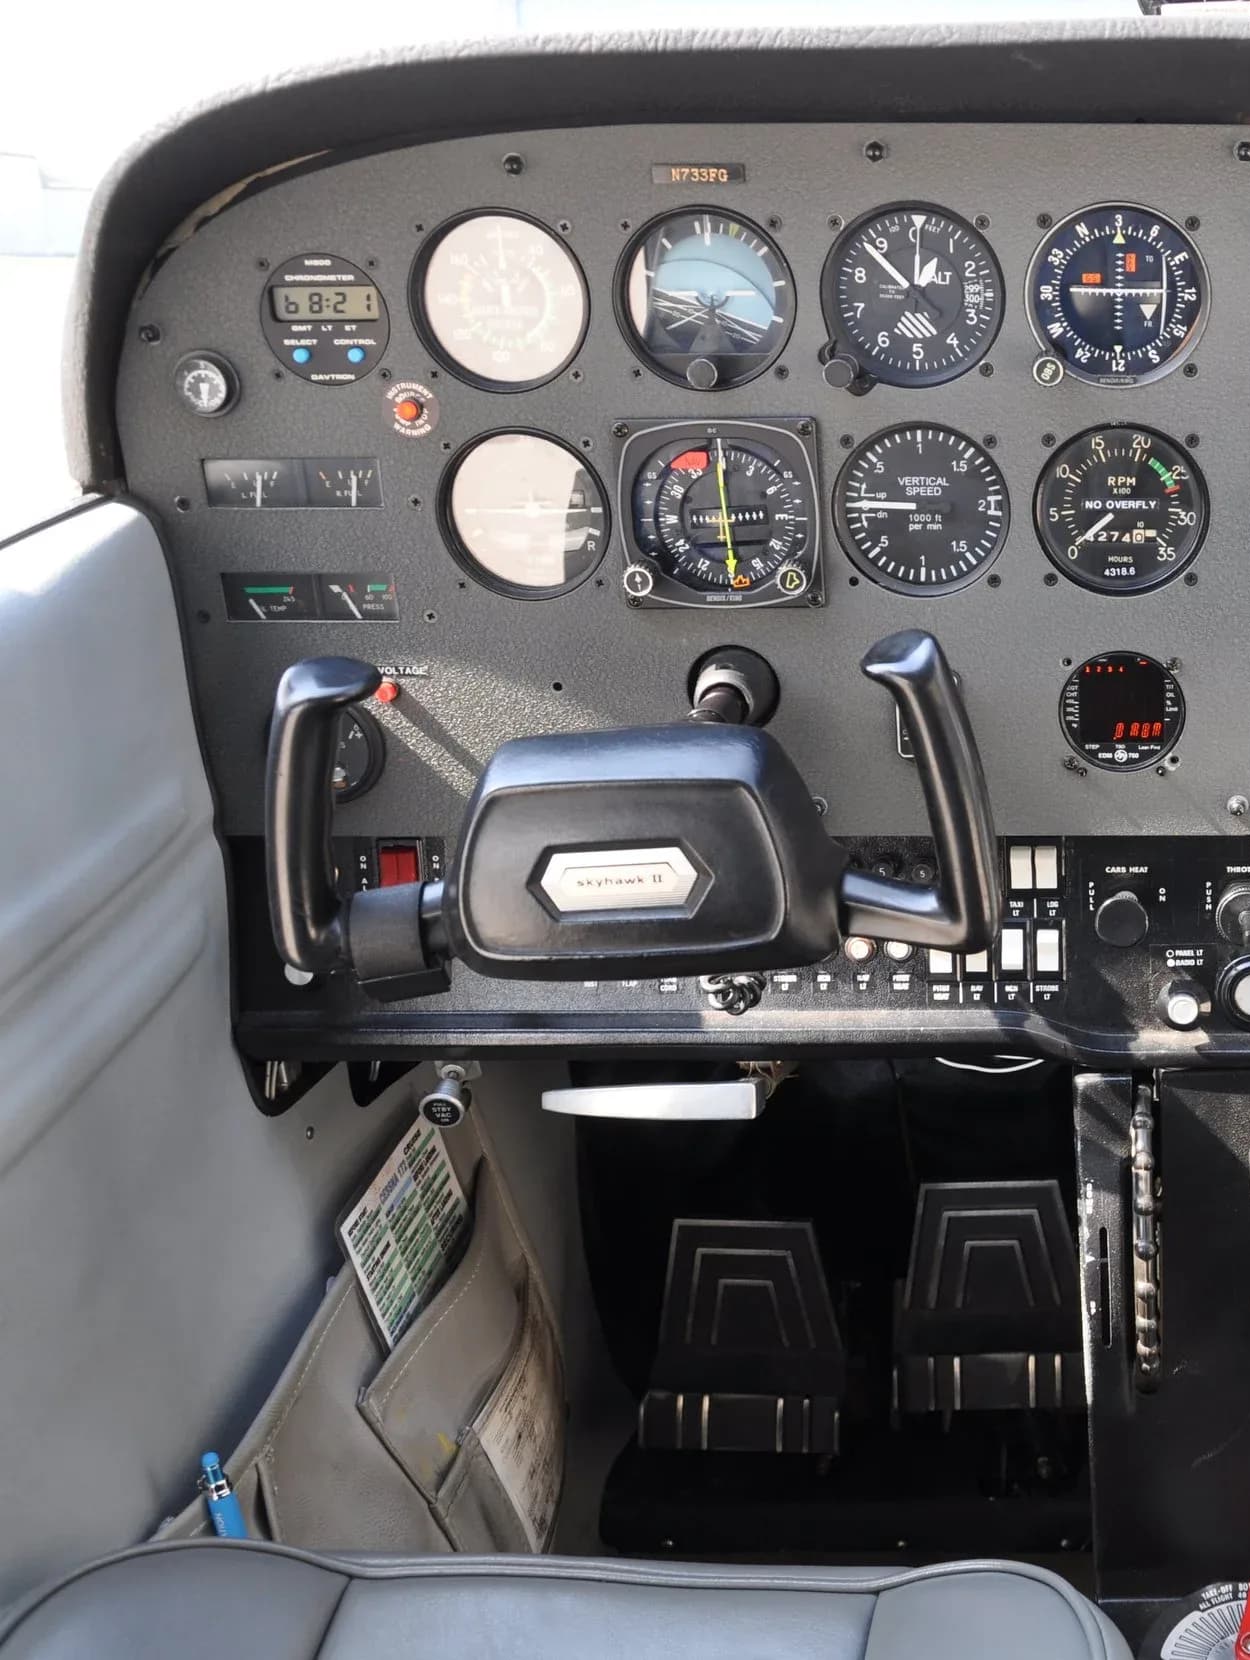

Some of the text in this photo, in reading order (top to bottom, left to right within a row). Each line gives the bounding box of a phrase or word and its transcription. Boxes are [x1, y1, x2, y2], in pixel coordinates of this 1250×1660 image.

[671, 168, 728, 182] N733FG
[925, 224, 941, 233] FEET
[1048, 248, 1064, 265] 33
[930, 272, 952, 285] ALT
[1040, 285, 1053, 300] 30
[1184, 286, 1197, 301] 12
[1173, 323, 1187, 338] 15
[1075, 349, 1091, 364] 24
[1112, 359, 1125, 372] 21
[1091, 435, 1104, 449] 15
[1132, 434, 1151, 448] 20
[951, 460, 967, 472] 1.5
[1056, 464, 1069, 478] 10
[1171, 465, 1189, 480] 25
[898, 476, 949, 486] VERTICAL
[1107, 476, 1136, 486] RPM
[671, 484, 685, 499] 30
[905, 486, 942, 496] SPEED
[1112, 487, 1131, 495] X100
[1085, 500, 1157, 509] NO OVERFLY
[909, 513, 942, 522] 1000 ft
[1177, 512, 1197, 526] 30
[908, 522, 942, 532] per min
[587, 540, 596, 551] R
[951, 540, 967, 552] 1.5
[1156, 547, 1176, 561] 35
[1104, 567, 1136, 576] 4318.6
[377, 665, 426, 677] VOLTAGE
[360, 855, 367, 869] ON
[432, 855, 440, 869] ON
[576, 875, 645, 887] skyhawk
[1158, 887, 1166, 902] ON
[1205, 881, 1213, 911] PUSH
[1035, 984, 1059, 992] STROBE
[379, 1176, 399, 1201] CESSNA
[1201, 1584, 1234, 1599] TAKE-OFF
[1199, 1598, 1211, 1610] ALL
